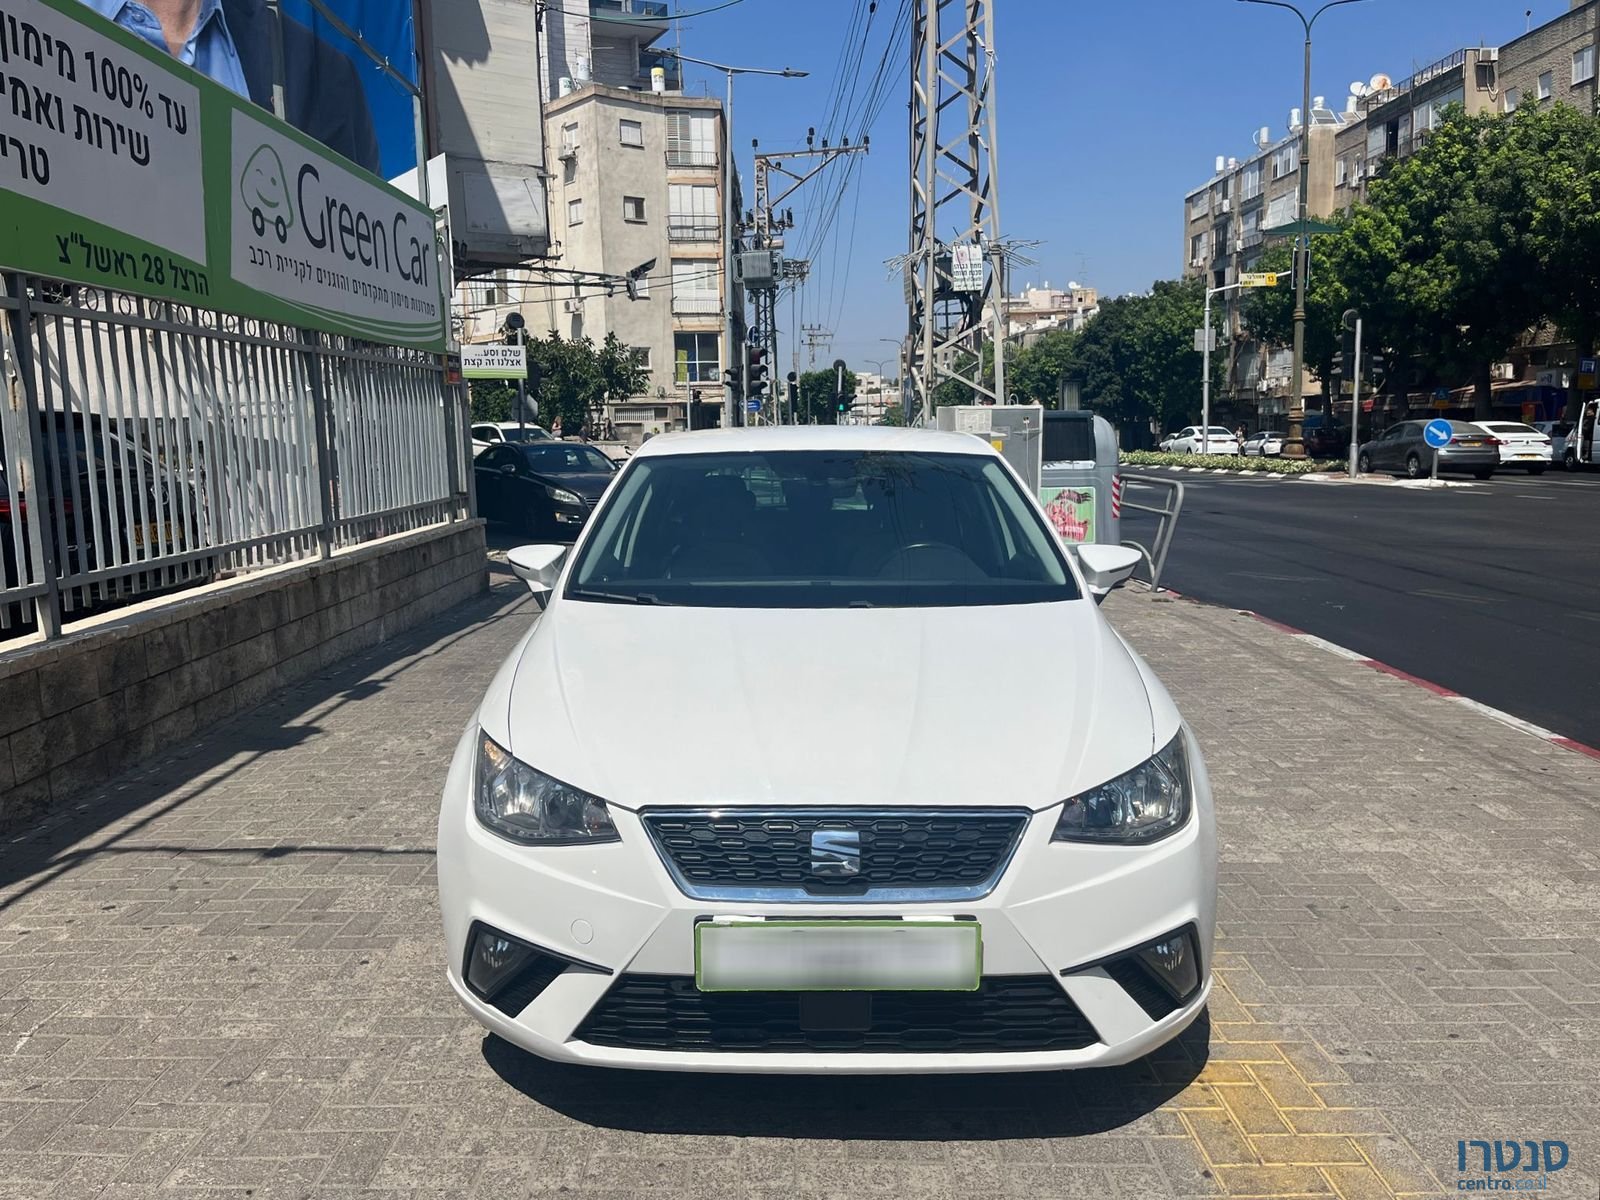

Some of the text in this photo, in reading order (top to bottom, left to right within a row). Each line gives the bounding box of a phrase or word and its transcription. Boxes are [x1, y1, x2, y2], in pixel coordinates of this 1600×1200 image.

[0, 10, 187, 135] עד 100% מימון
[73, 103, 150, 166] שירות
[297, 163, 429, 287] Green Car
[141, 252, 165, 286] 28
[168, 257, 209, 297] הרצל
[248, 245, 436, 317] פתרונות מימון מתקדמים והוגנים לקניית רכב
[464, 357, 521, 368] אצלנו זה קצת
[501, 348, 521, 357] שלם
